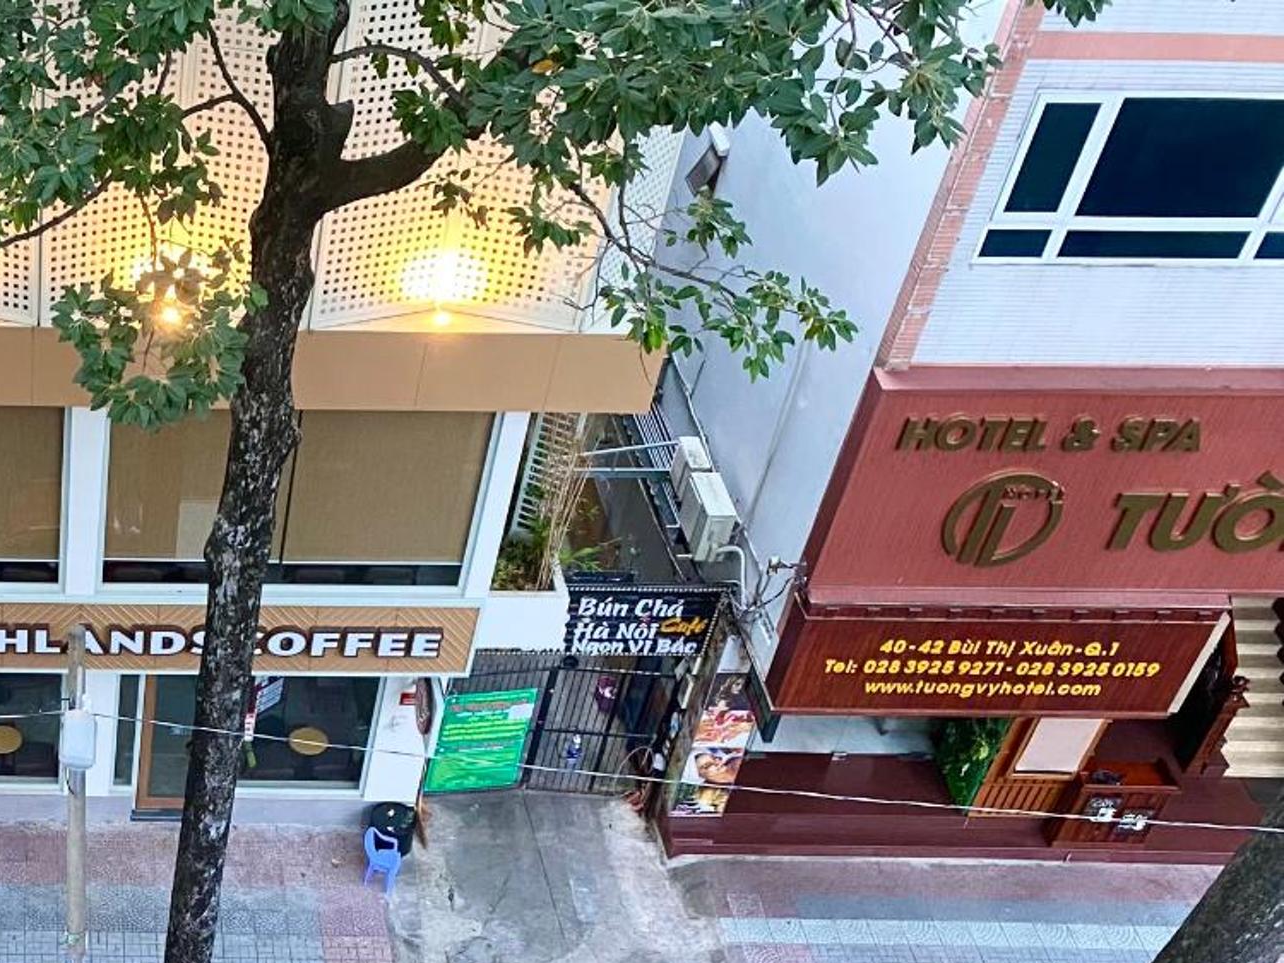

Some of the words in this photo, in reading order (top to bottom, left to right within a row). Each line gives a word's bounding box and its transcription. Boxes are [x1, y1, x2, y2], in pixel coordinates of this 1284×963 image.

[895, 413, 1049, 452] HOTEL
[1061, 414, 1101, 452] &
[1111, 414, 1202, 452] SPA
[1105, 471, 1284, 554] TƯỜ
[578, 596, 629, 617] Bún
[573, 621, 610, 640] Hà
[253, 625, 442, 658] OFFEE
[948, 639, 982, 655] Bùi
[986, 640, 1016, 658] Thị
[825, 659, 858, 674] Tel:
[864, 660, 900, 674] 028
[904, 660, 955, 674] 3925
[958, 661, 1004, 675] 9271
[1016, 662, 1055, 676] 028
[1058, 662, 1111, 677] 3925
[1112, 662, 1160, 677] 0159
[865, 680, 1102, 698] www.tuongvyhotel.com
